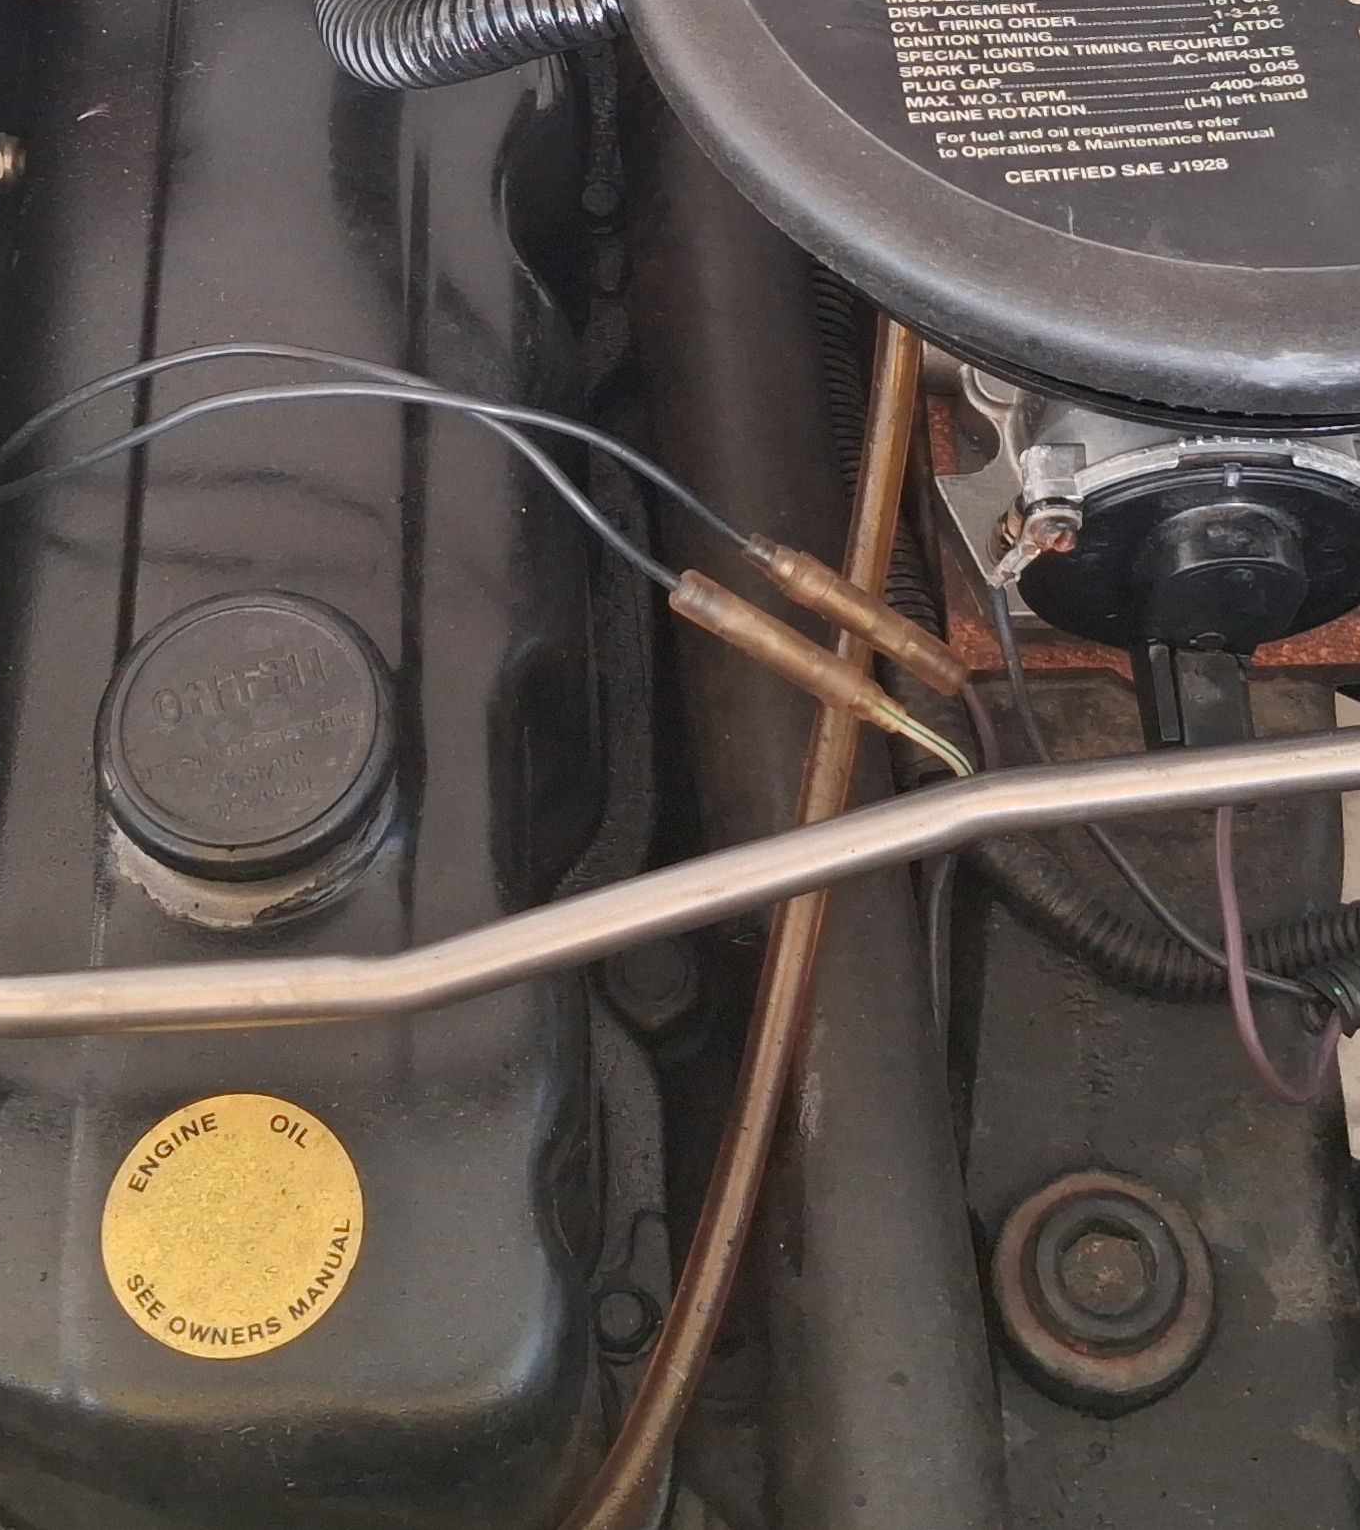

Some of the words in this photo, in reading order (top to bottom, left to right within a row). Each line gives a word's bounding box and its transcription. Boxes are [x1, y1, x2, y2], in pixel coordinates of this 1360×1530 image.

[888, 3, 1037, 19] DISPLACEMENT
[890, 21, 935, 34] CYL.
[939, 18, 1003, 32] FIRING
[1008, 16, 1077, 29] ORDER
[1213, 5, 1281, 20] 1-3-4-2
[893, 34, 980, 48] IGNITION
[982, 31, 1053, 45] TIMING
[1232, 18, 1286, 32] ATDC
[896, 49, 979, 63] SPECIAL
[983, 45, 1069, 60] IGNITION
[1073, 41, 1143, 56] TIMING
[1147, 35, 1250, 52] REQUIRED
[899, 64, 965, 78] SPARK
[969, 61, 1036, 75] PLUGS
[1172, 45, 1296, 66] AC-MR43LTS
[902, 79, 956, 94] PLUG
[960, 78, 1001, 91] GAP
[1249, 60, 1299, 74] 0.045
[905, 95, 955, 109] MAX.
[959, 92, 1018, 106] W.O.T.
[1209, 74, 1306, 92] 4400-4800
[908, 109, 985, 124] ENGINE
[988, 104, 1086, 120] ROTATION
[1184, 96, 1222, 110] (LH)
[1225, 91, 1256, 106] left
[1260, 88, 1308, 103] hand
[935, 131, 966, 144] For
[970, 129, 1004, 143] fuel
[1009, 127, 1042, 141] and
[1047, 126, 1069, 139] oil
[1072, 119, 1193, 140] requirements
[1196, 115, 1241, 129] refer
[938, 146, 958, 159] to
[961, 141, 1062, 159] Operations
[1067, 140, 1081, 152] &
[1085, 134, 1203, 151] Maintenance
[1207, 126, 1276, 143] Manual
[1005, 165, 1117, 185] CERTIFIED
[1121, 162, 1165, 177] SAE
[1169, 157, 1230, 174] J1928
[127, 1112, 218, 1194] ENGINE
[270, 1113, 309, 1150] OIL
[126, 1272, 167, 1320] SEE
[168, 1315, 283, 1346] OWNERS
[287, 1218, 351, 1321] MANUAL
